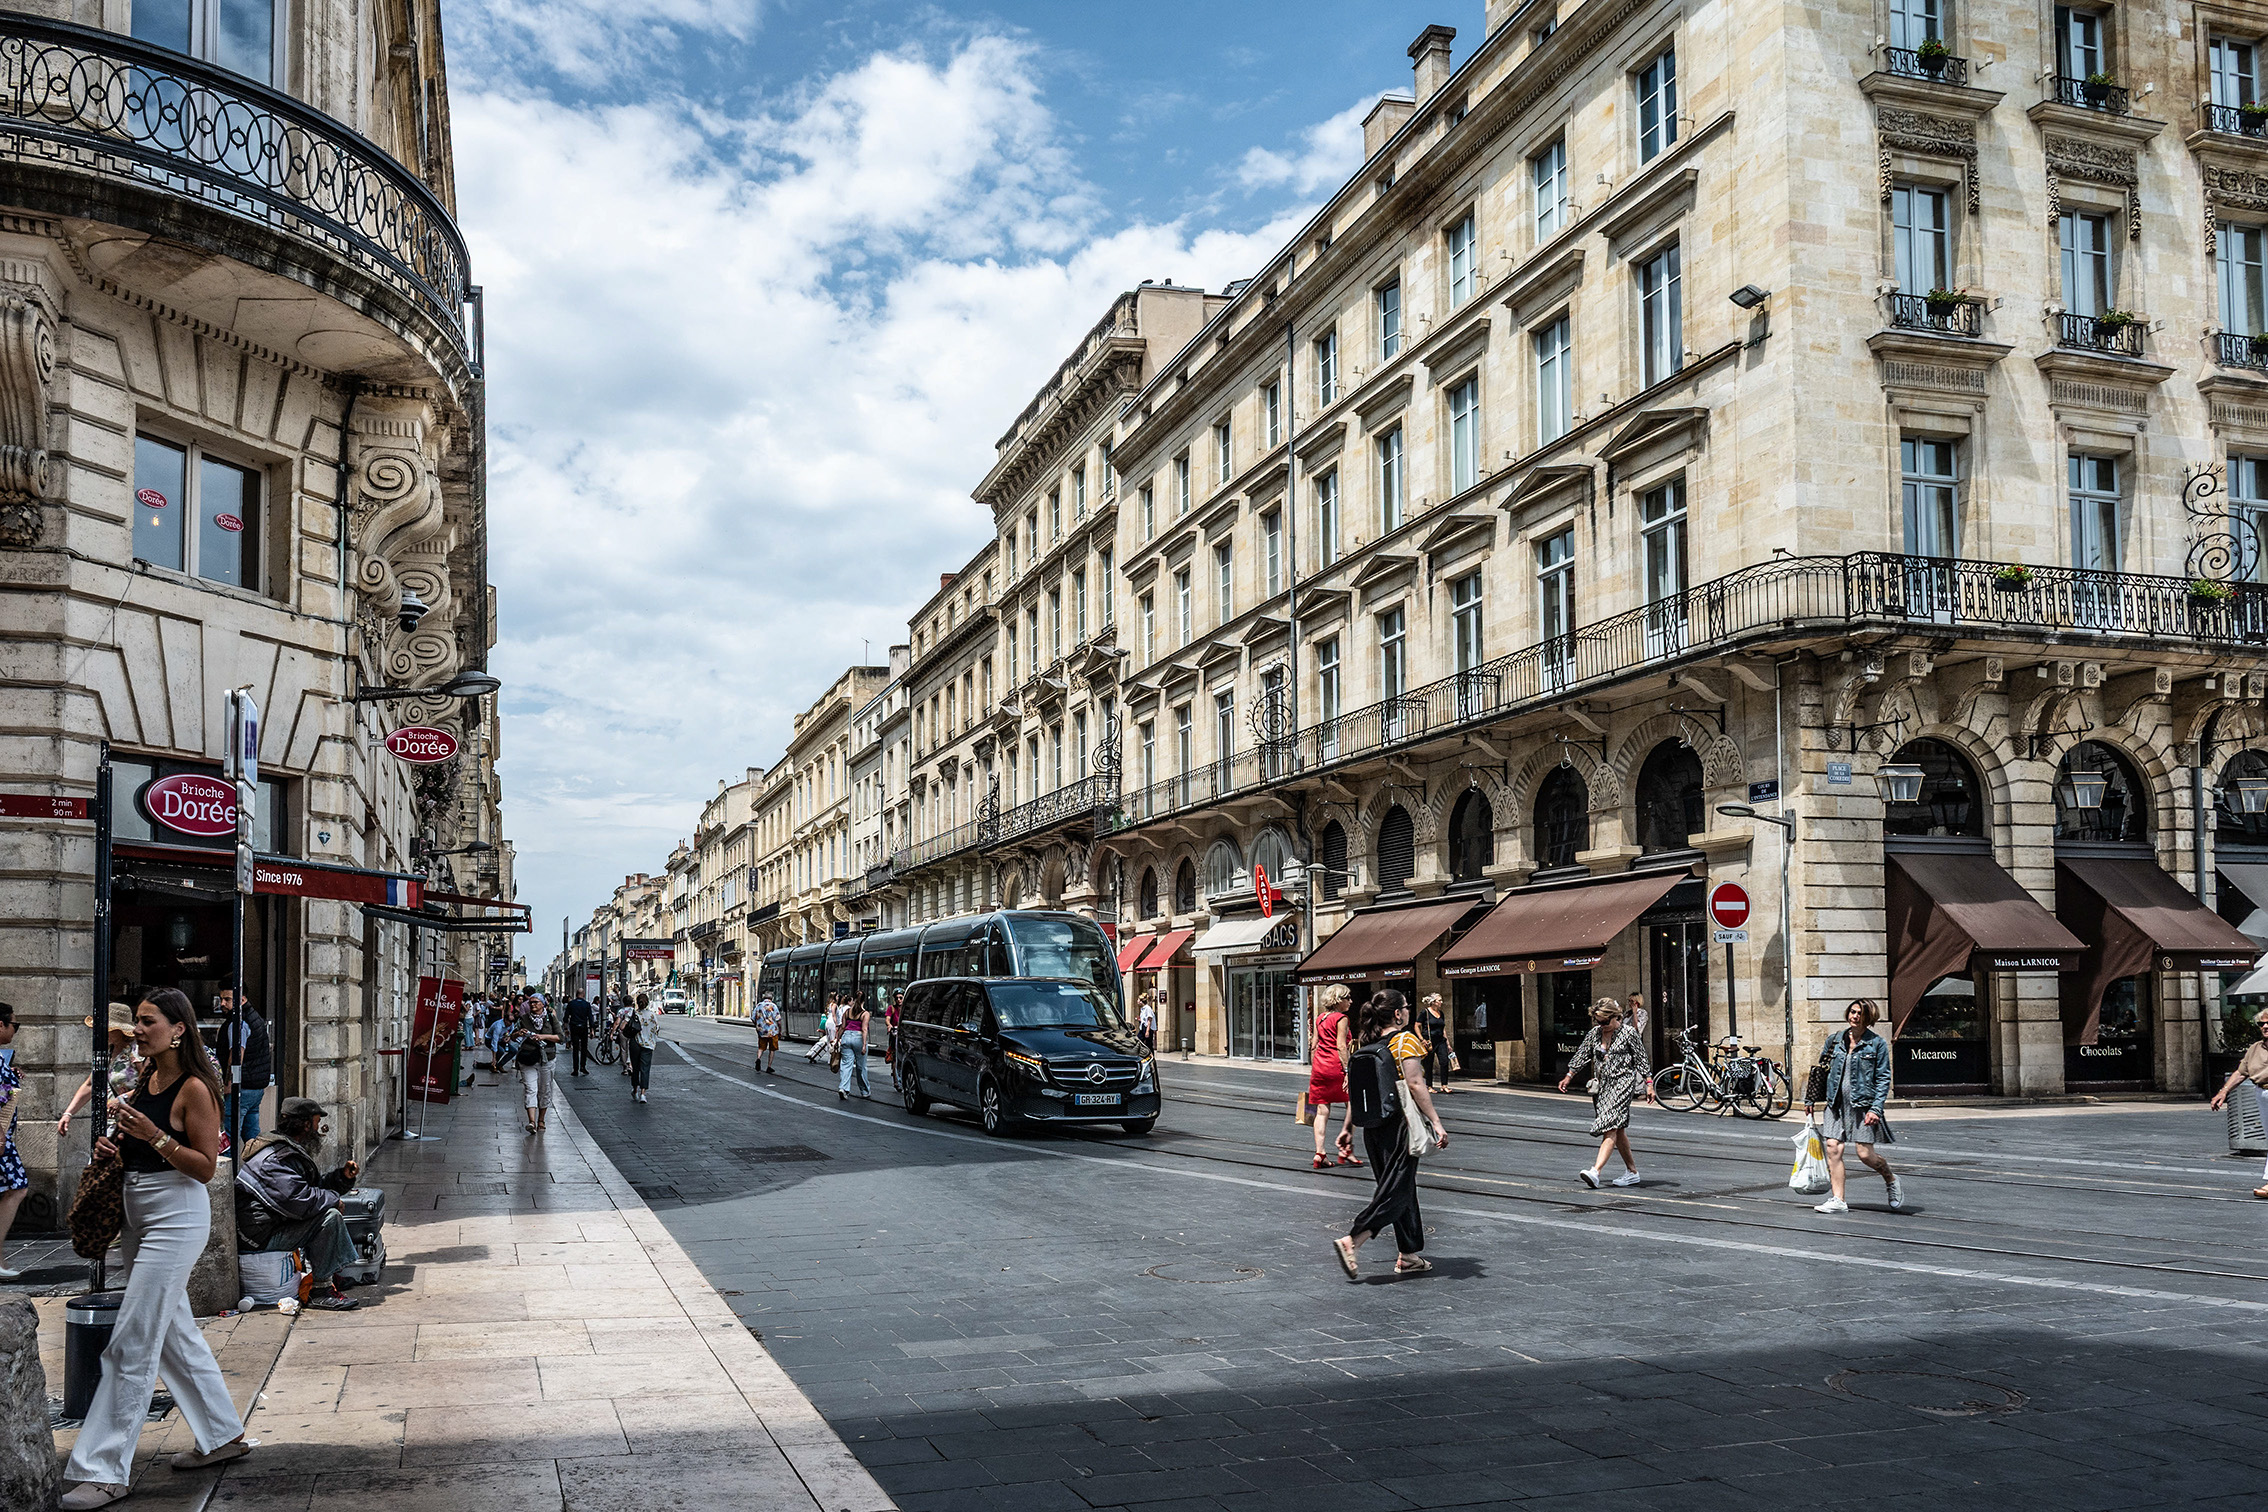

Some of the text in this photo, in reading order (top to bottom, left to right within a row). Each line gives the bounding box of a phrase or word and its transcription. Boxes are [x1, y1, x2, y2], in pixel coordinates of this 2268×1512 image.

[142, 492, 165, 507] Dorée
[220, 516, 241, 530] Dorée
[408, 731, 439, 741] Brioche
[395, 737, 449, 755] Dorée
[181, 782, 225, 799] Brioche
[58, 799, 73, 807] min
[162, 789, 236, 825] Dorée
[53, 808, 64, 816] 90
[256, 869, 303, 886] Since 1976
[1259, 874, 1269, 908] TABAC
[1260, 924, 1295, 948] BACS
[1994, 958, 2060, 967] Maison LARNICOL
[1460, 966, 1477, 974] Georges
[1477, 964, 1501, 973] LARNICOL
[1471, 1041, 1493, 1050] Biscuits
[1557, 1043, 1578, 1053] Macar
[2080, 1045, 2122, 1056] Chocolats
[1911, 1048, 1957, 1060] Macarons
